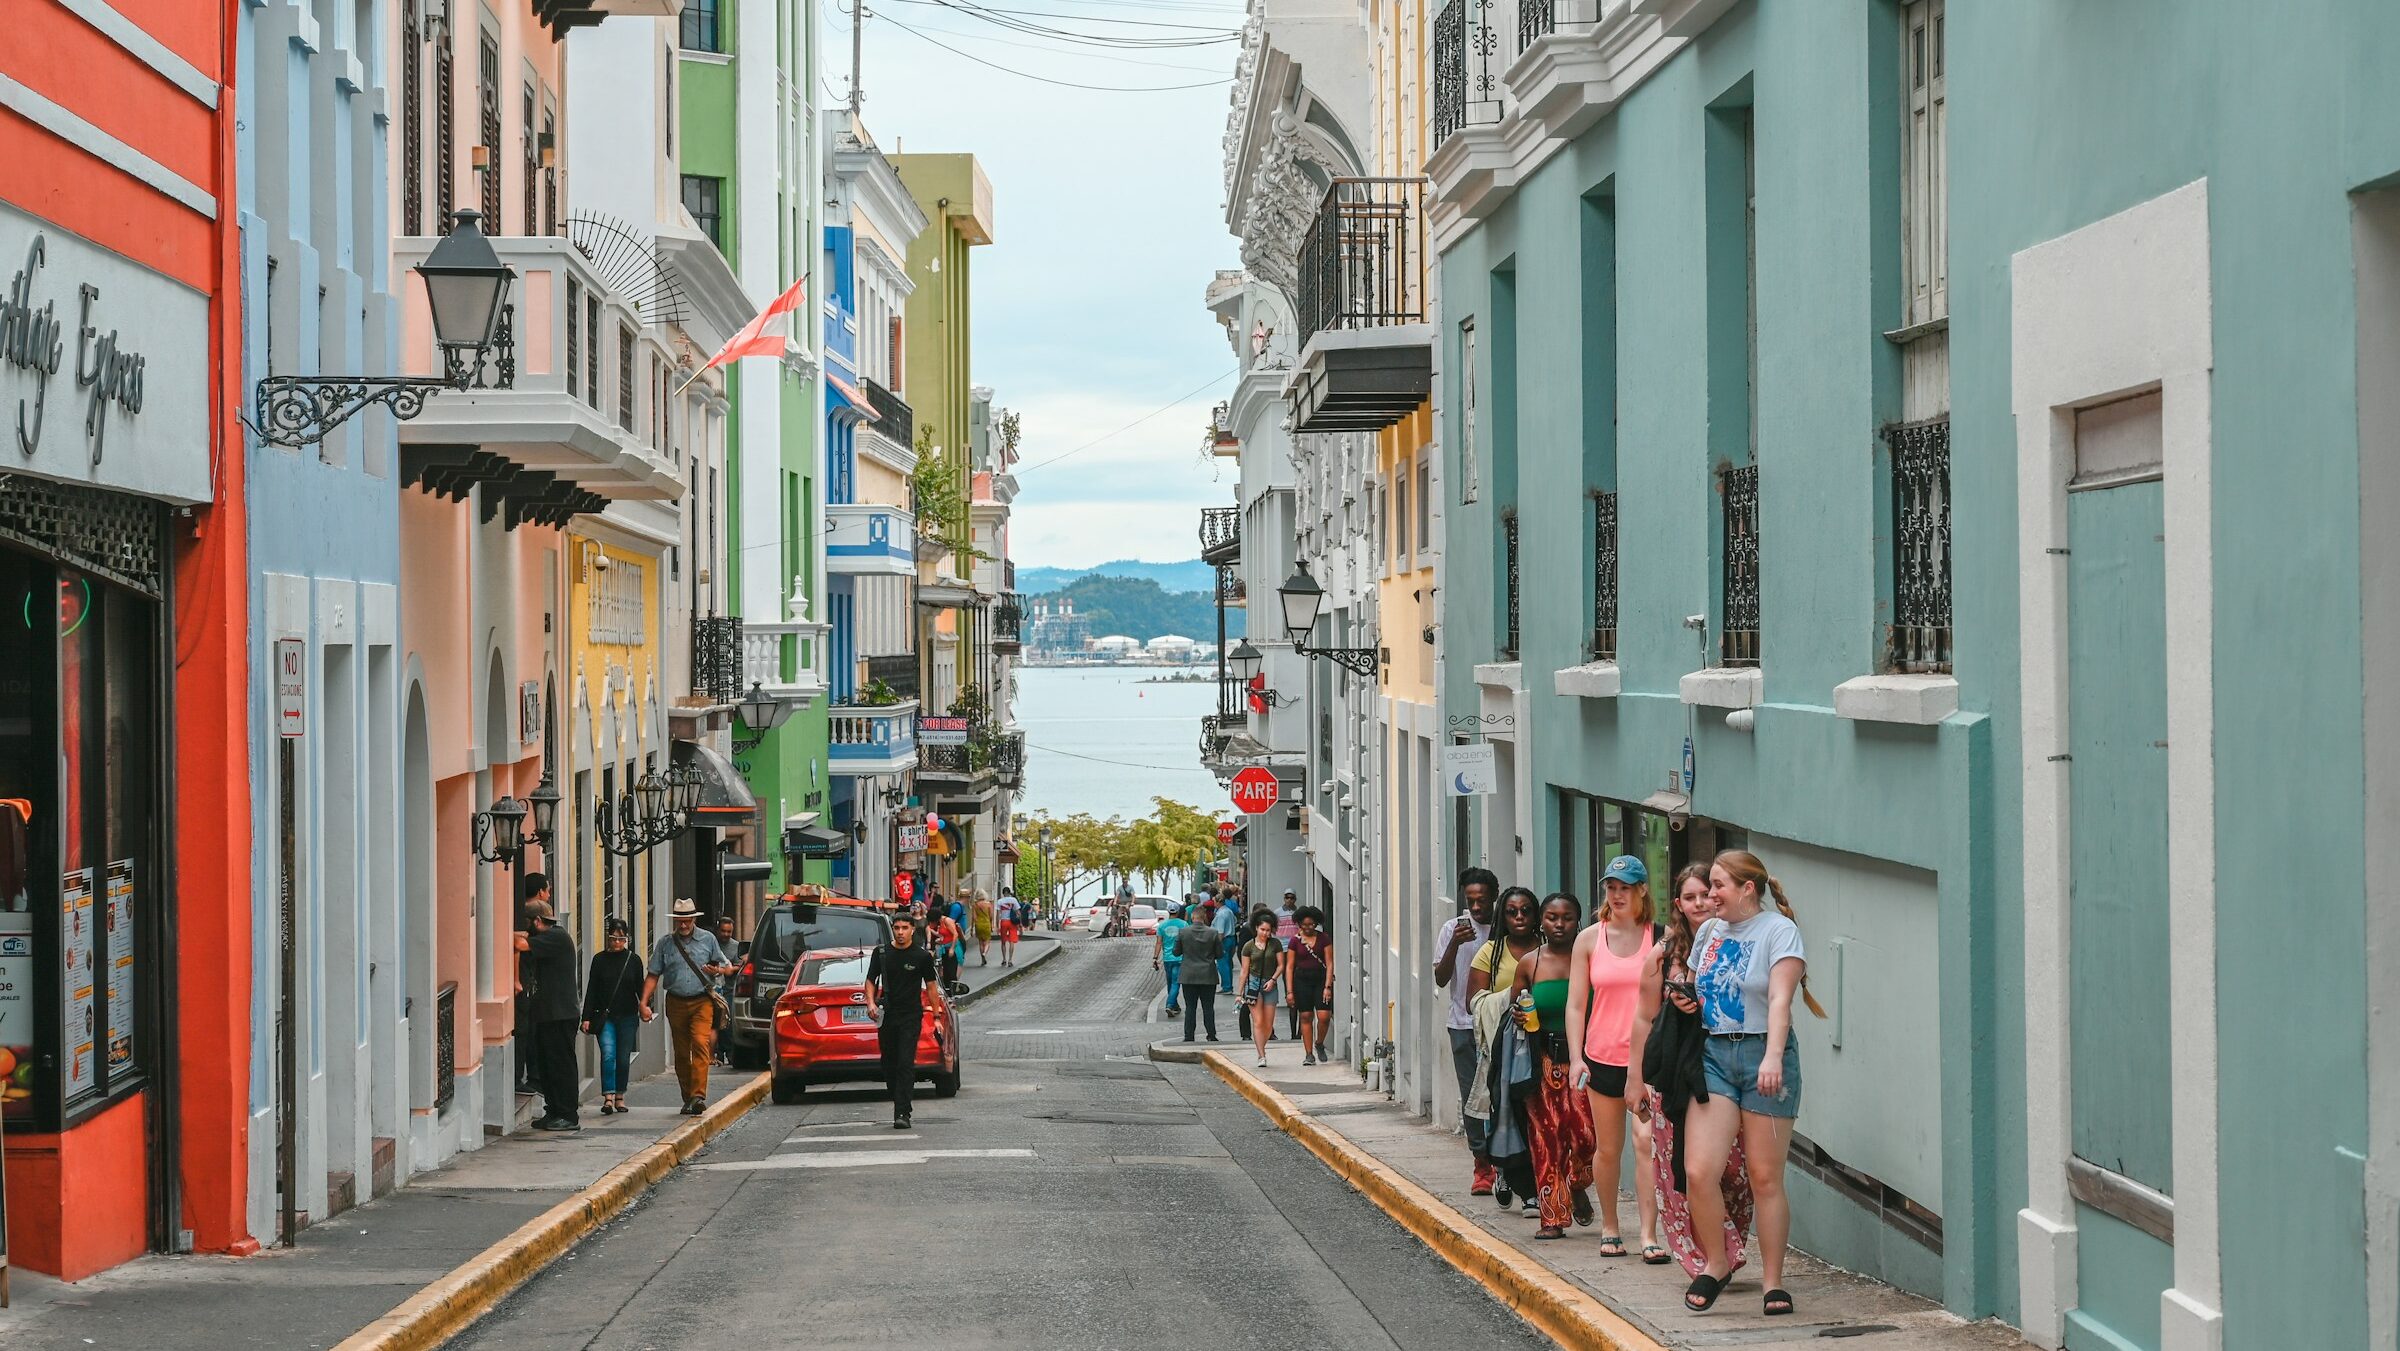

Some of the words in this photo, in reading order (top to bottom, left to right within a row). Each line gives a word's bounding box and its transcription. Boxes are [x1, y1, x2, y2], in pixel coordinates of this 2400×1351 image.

[77, 282, 145, 465] Express
[285, 651, 298, 675] NO
[922, 717, 940, 730] FOR
[941, 717, 967, 730] LEASE
[1232, 781, 1276, 800] PARE
[900, 835, 906, 848] 4
[917, 834, 928, 847] 10
